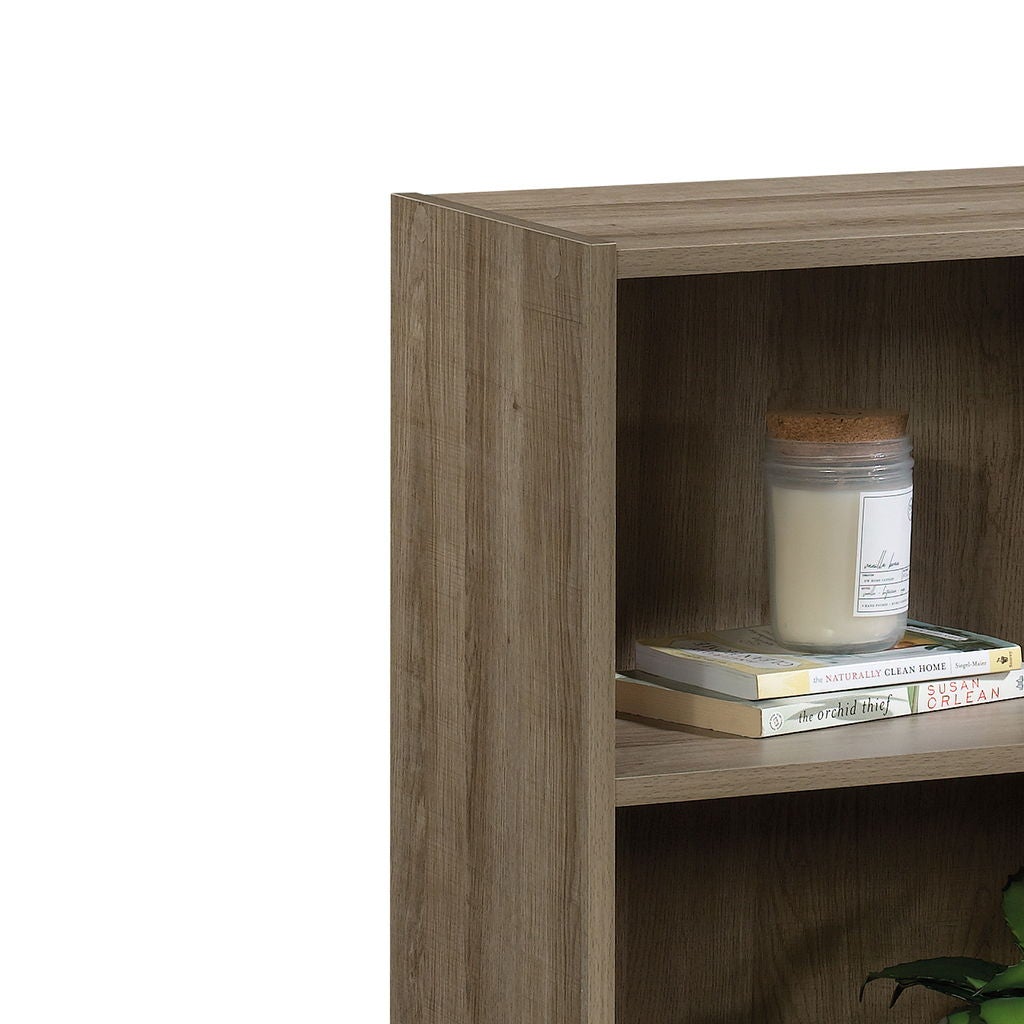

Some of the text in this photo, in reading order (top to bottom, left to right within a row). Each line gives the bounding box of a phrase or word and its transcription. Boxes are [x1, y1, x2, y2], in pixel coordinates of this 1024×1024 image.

[813, 662, 947, 684] the NATURALLY CLEAN HOME
[927, 678, 980, 696] SUSAN
[927, 686, 1000, 710] ORLEAN
[798, 710, 813, 724] the
[817, 699, 857, 720] orchid
[862, 694, 892, 716] thief
